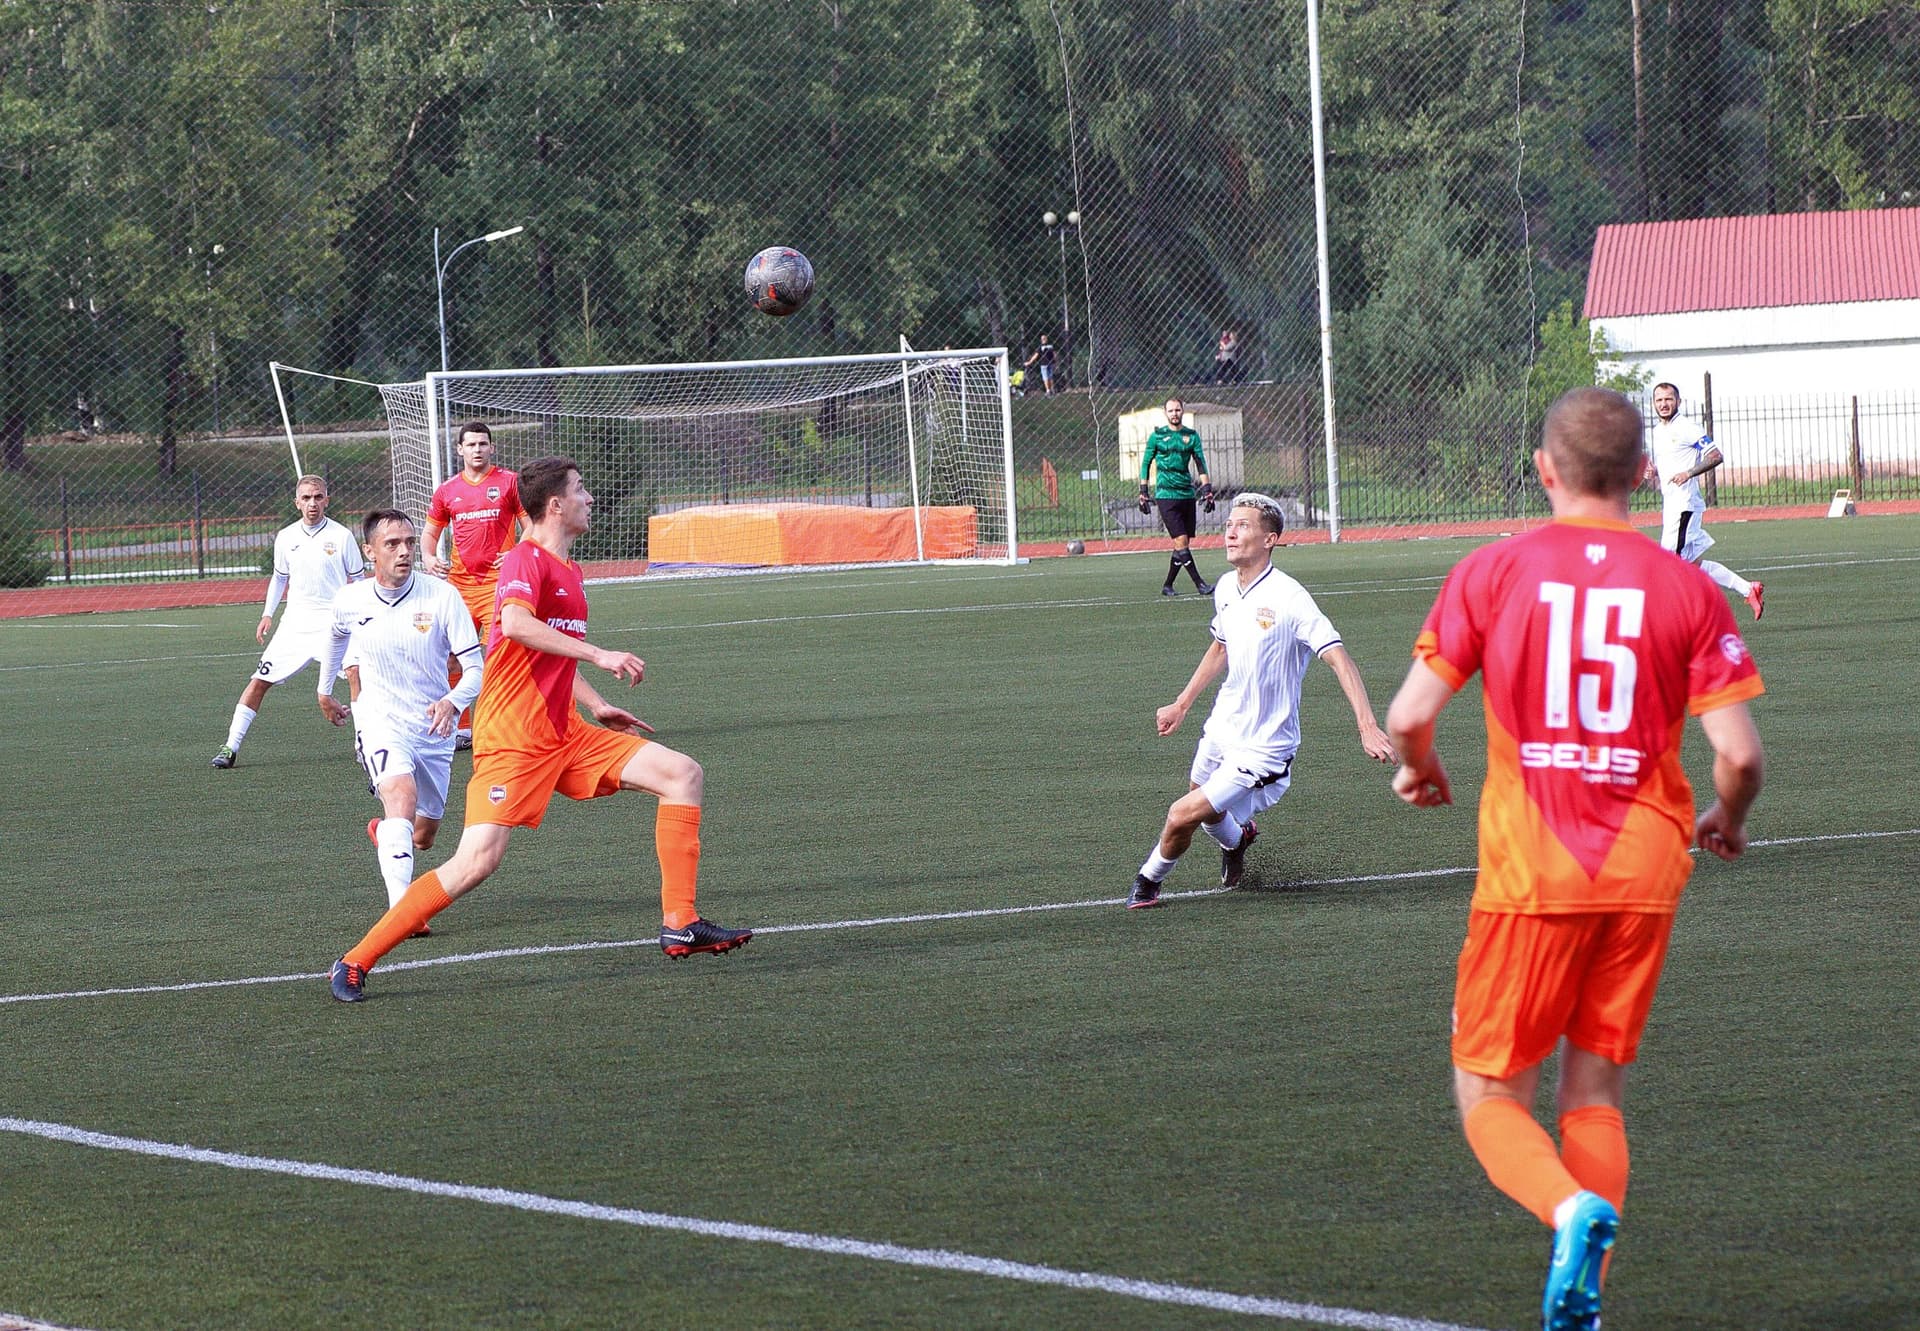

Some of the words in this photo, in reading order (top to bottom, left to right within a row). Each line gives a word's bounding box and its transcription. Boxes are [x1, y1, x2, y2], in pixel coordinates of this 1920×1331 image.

[1539, 581, 1646, 734] 15
[370, 748, 389, 777] 17
[1520, 741, 1641, 774] SEUS
